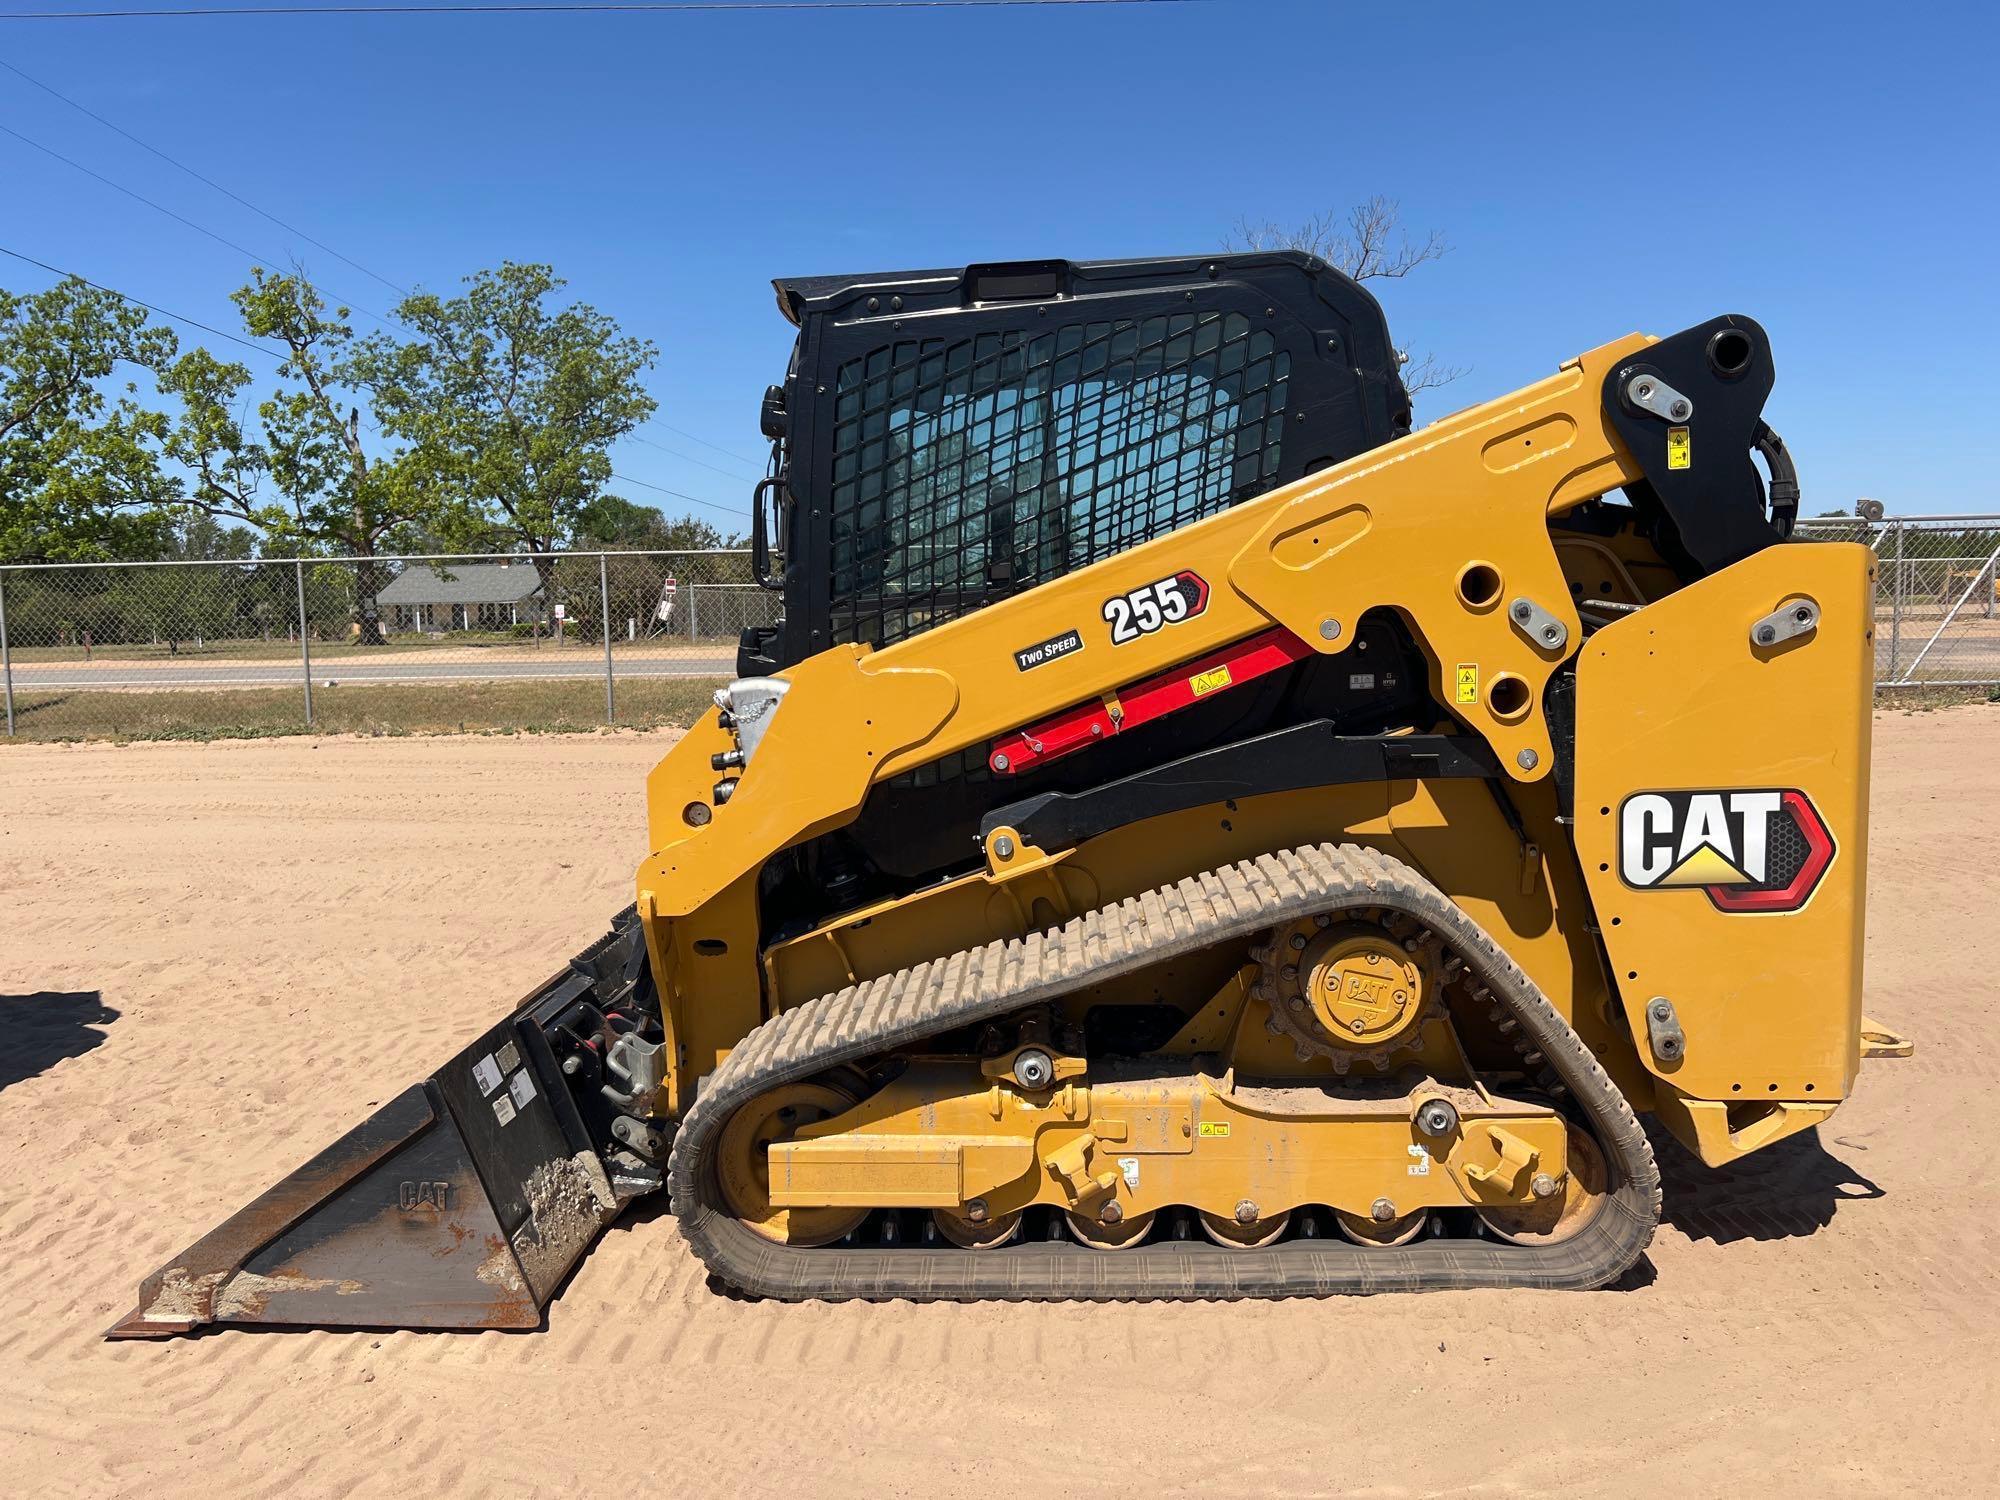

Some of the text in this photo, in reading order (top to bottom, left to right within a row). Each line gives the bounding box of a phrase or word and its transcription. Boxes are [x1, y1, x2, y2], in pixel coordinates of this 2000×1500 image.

[1104, 577, 1188, 643] 255
[1622, 792, 1781, 886] CAT
[1346, 976, 1384, 1005] CAT
[400, 1181, 449, 1212] CAT
